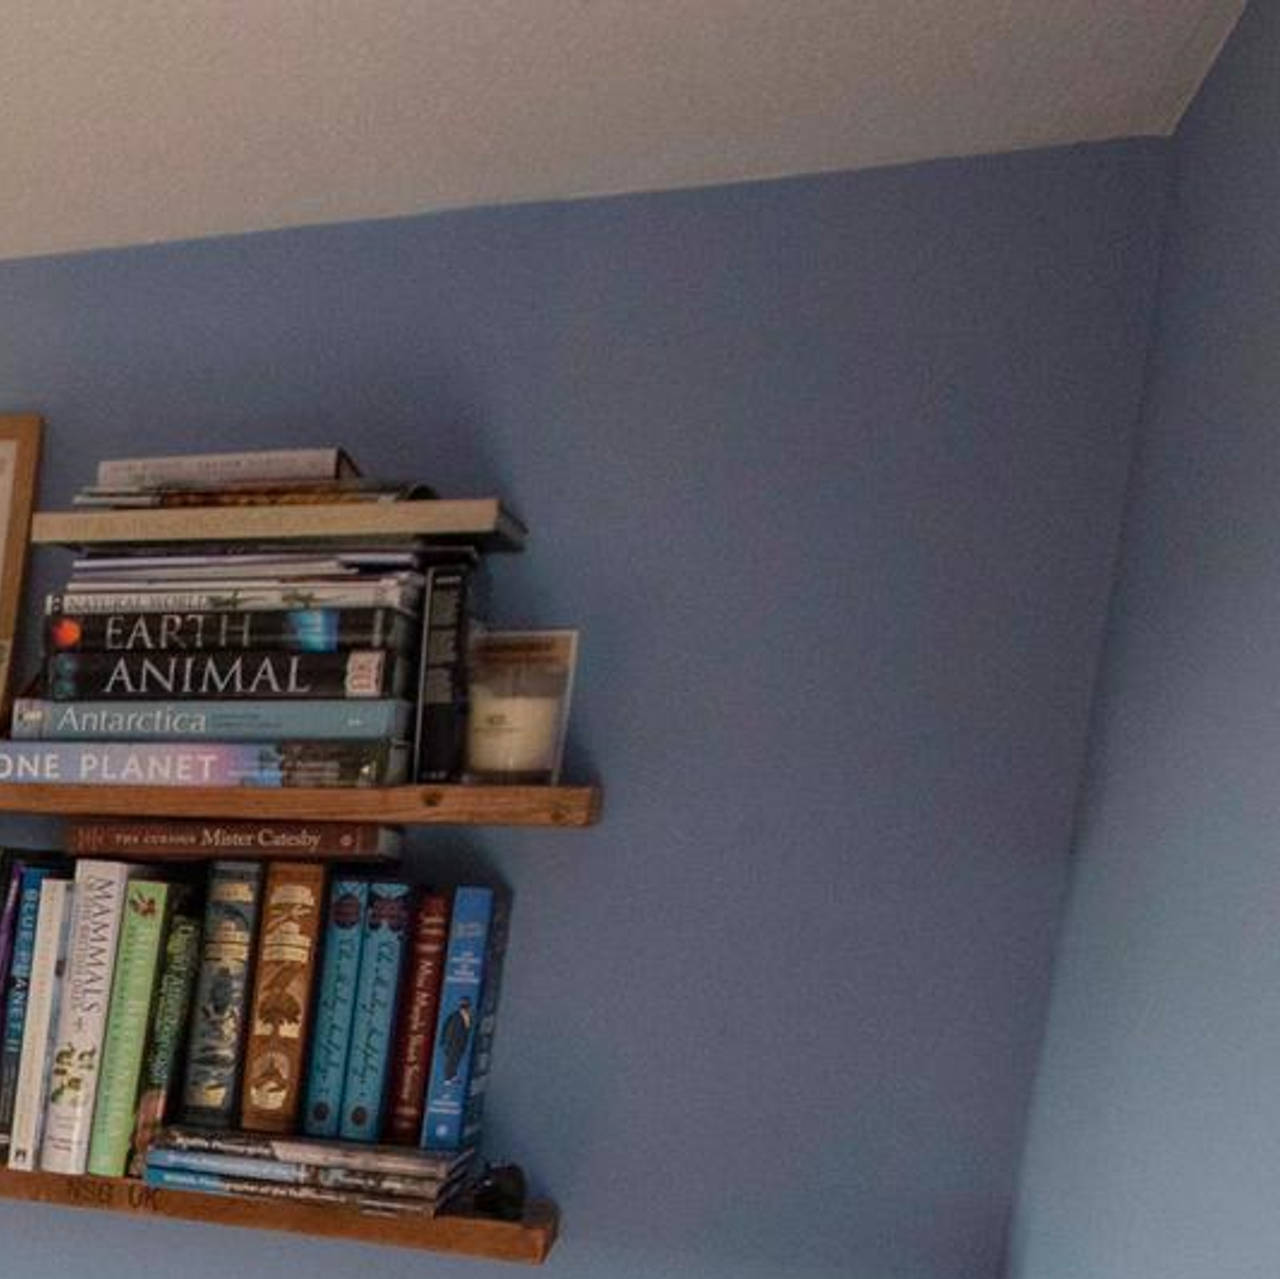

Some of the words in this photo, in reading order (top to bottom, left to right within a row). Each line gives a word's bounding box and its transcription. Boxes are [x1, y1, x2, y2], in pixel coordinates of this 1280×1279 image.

[105, 613, 251, 649] EARTH
[103, 655, 311, 694] ANIMAL
[57, 706, 207, 734] Antarctica
[80, 754, 218, 781] PLANET
[200, 828, 254, 847] Mister
[257, 829, 321, 852] Catesby
[82, 877, 115, 1021] MAMMALS
